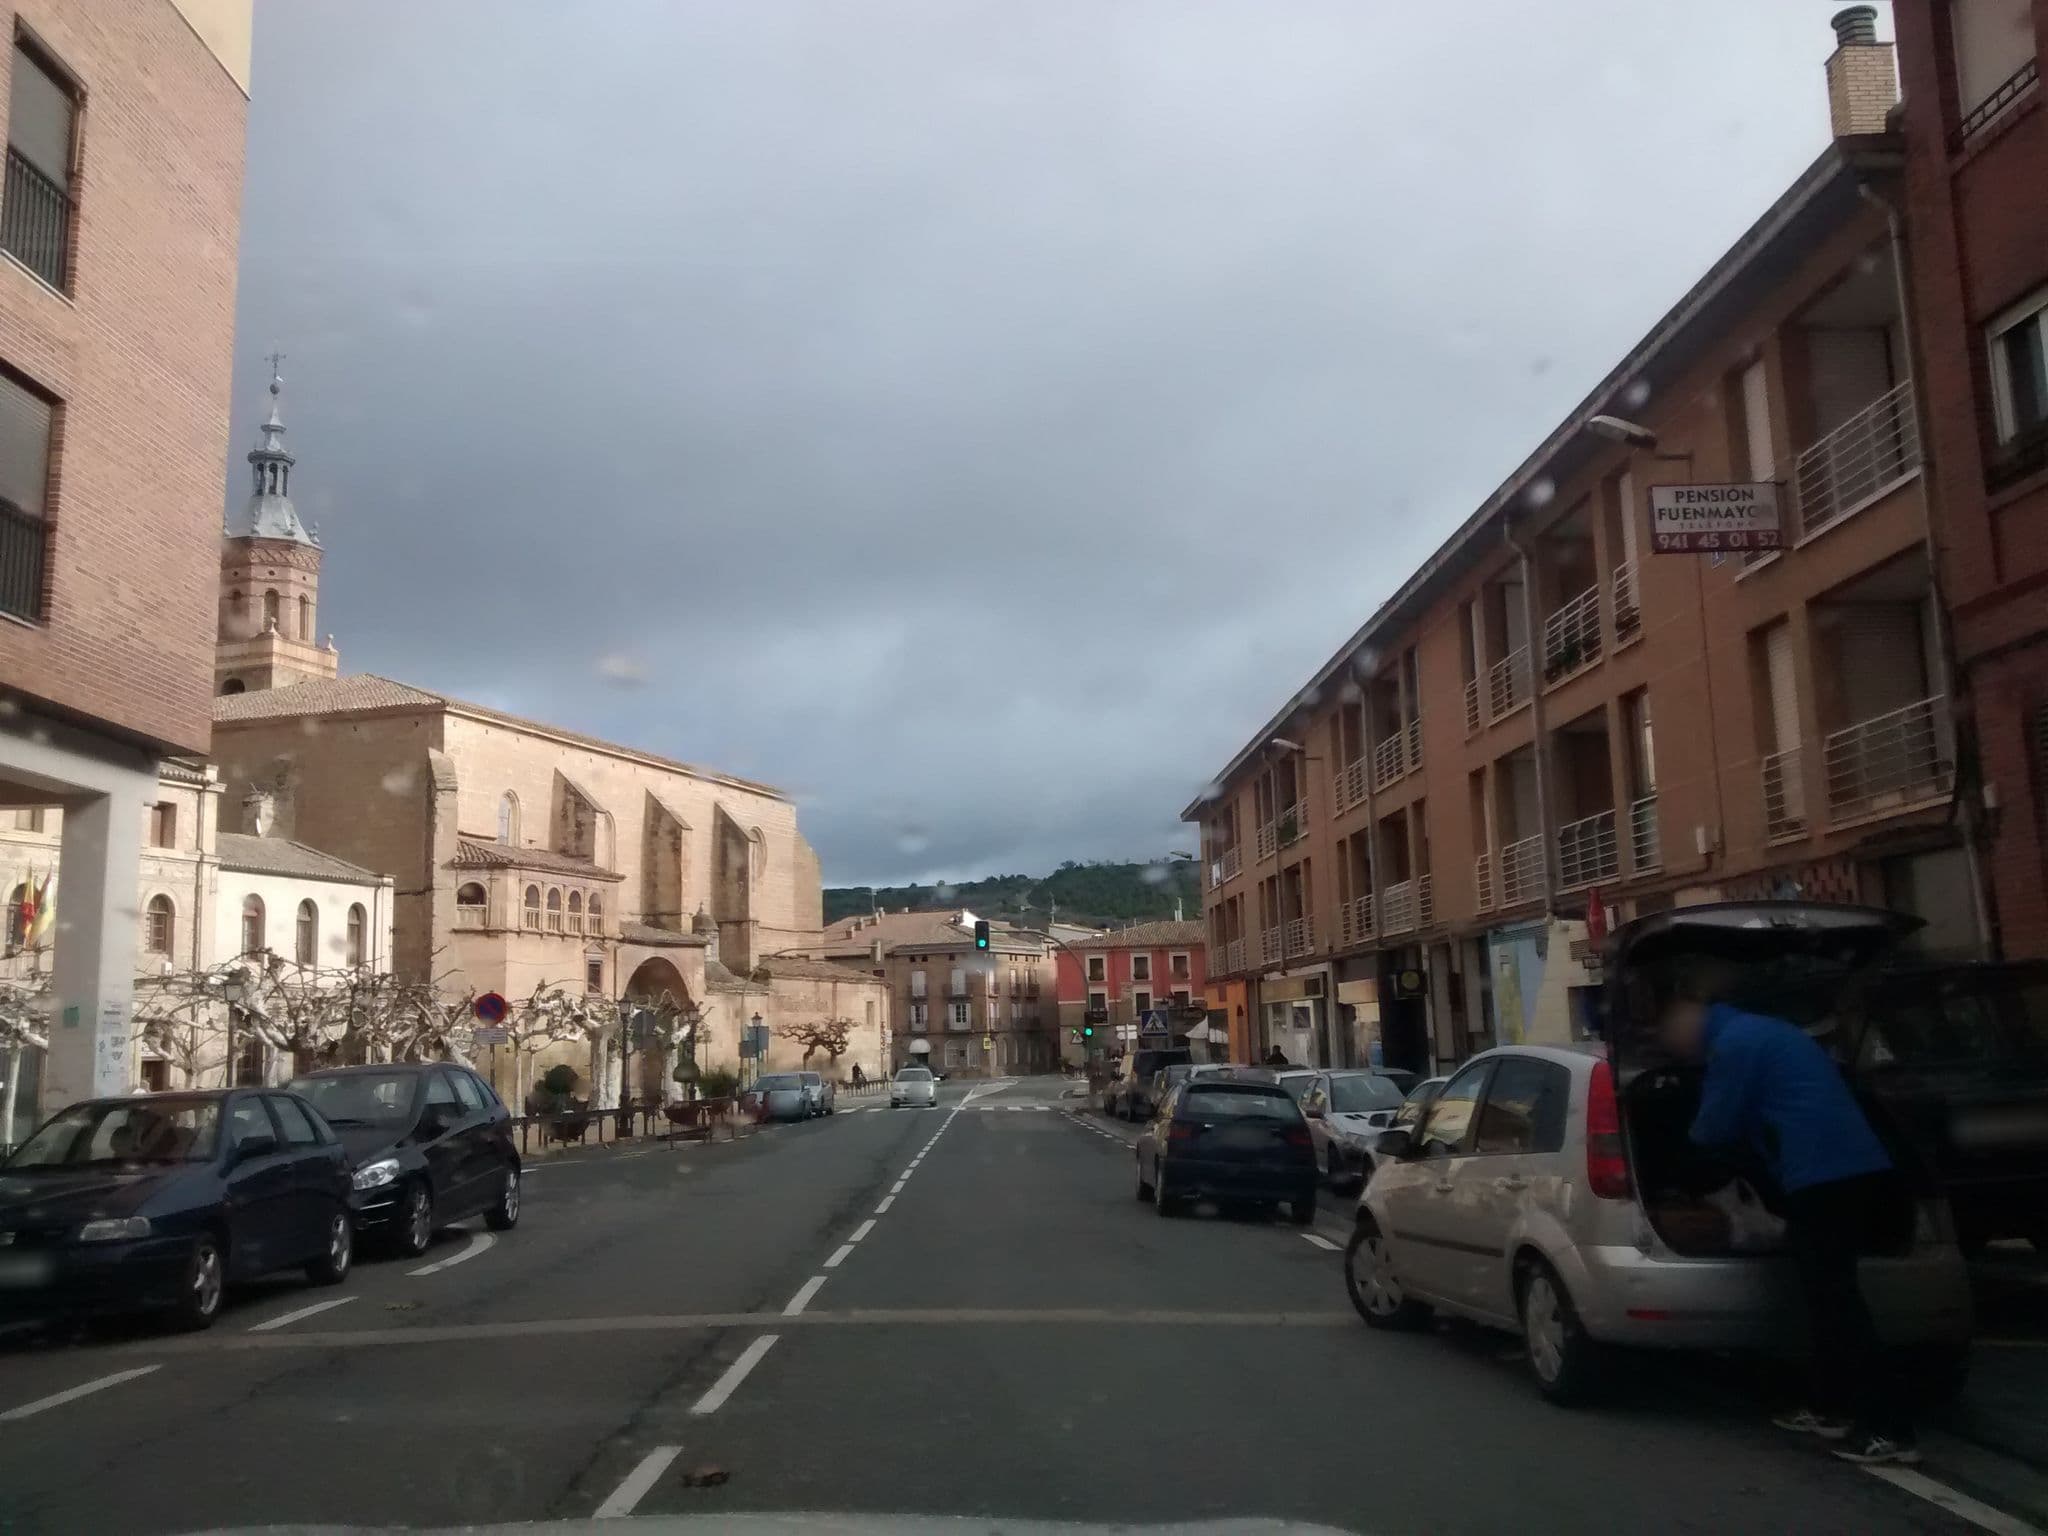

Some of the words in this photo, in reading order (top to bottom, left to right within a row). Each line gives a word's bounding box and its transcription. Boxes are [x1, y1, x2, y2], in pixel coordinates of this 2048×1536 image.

[1675, 488, 1754, 503] PENSION
[1659, 534, 1689, 549] 941
[1698, 533, 1720, 548] 45
